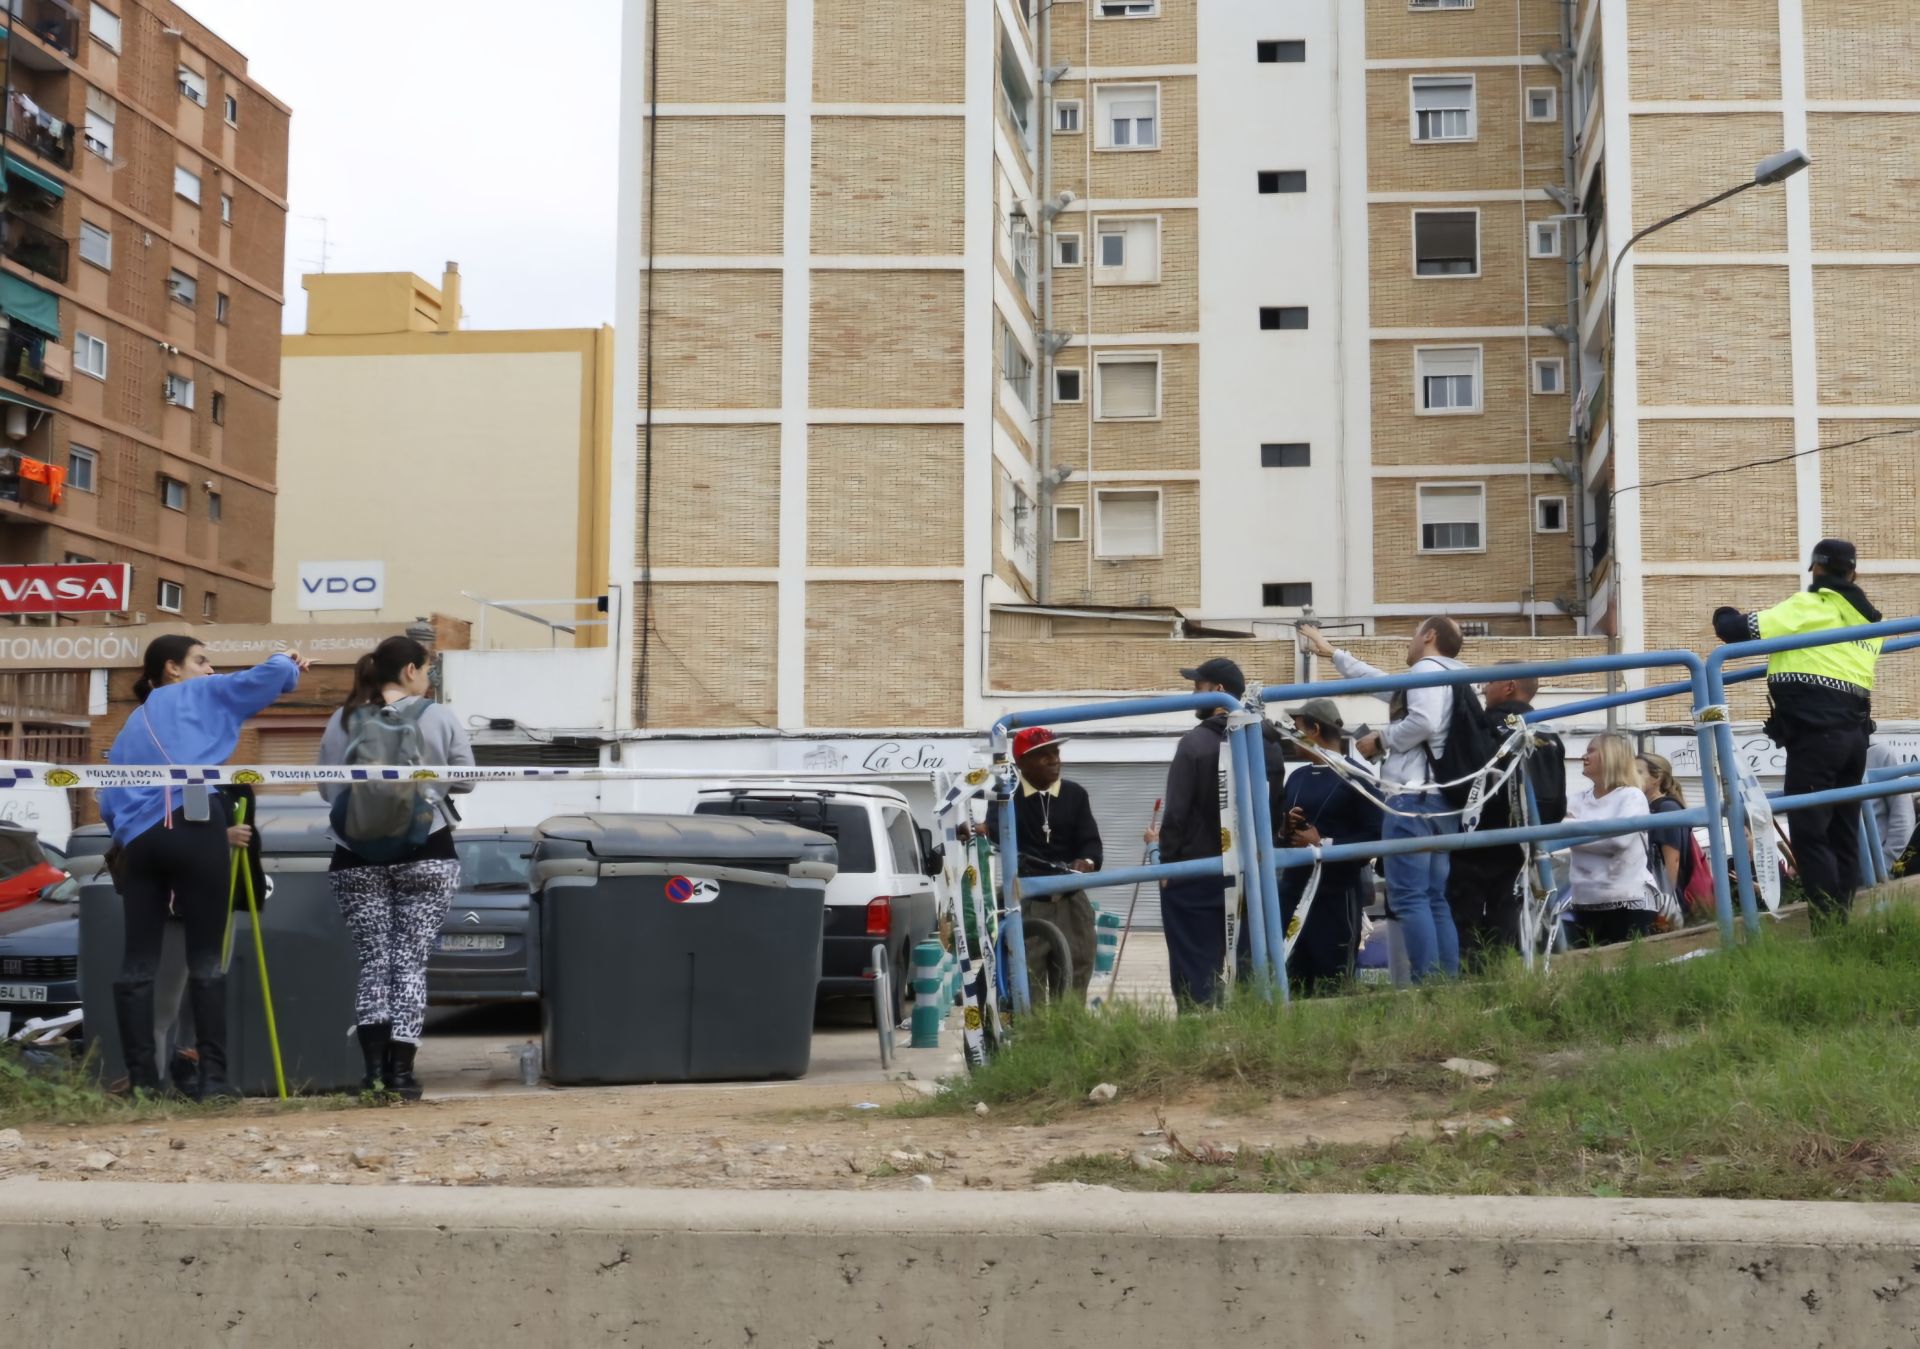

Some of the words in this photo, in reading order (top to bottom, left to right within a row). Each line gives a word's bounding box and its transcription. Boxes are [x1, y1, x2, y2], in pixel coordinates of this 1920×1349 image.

[0, 577, 117, 601] VASA
[302, 577, 376, 593] VDO
[0, 632, 138, 660] TOMOCIÓN
[203, 639, 287, 651] ACÓGRAFOS
[311, 637, 382, 651] DESCARG
[863, 742, 900, 774] La
[901, 744, 945, 770] Seu
